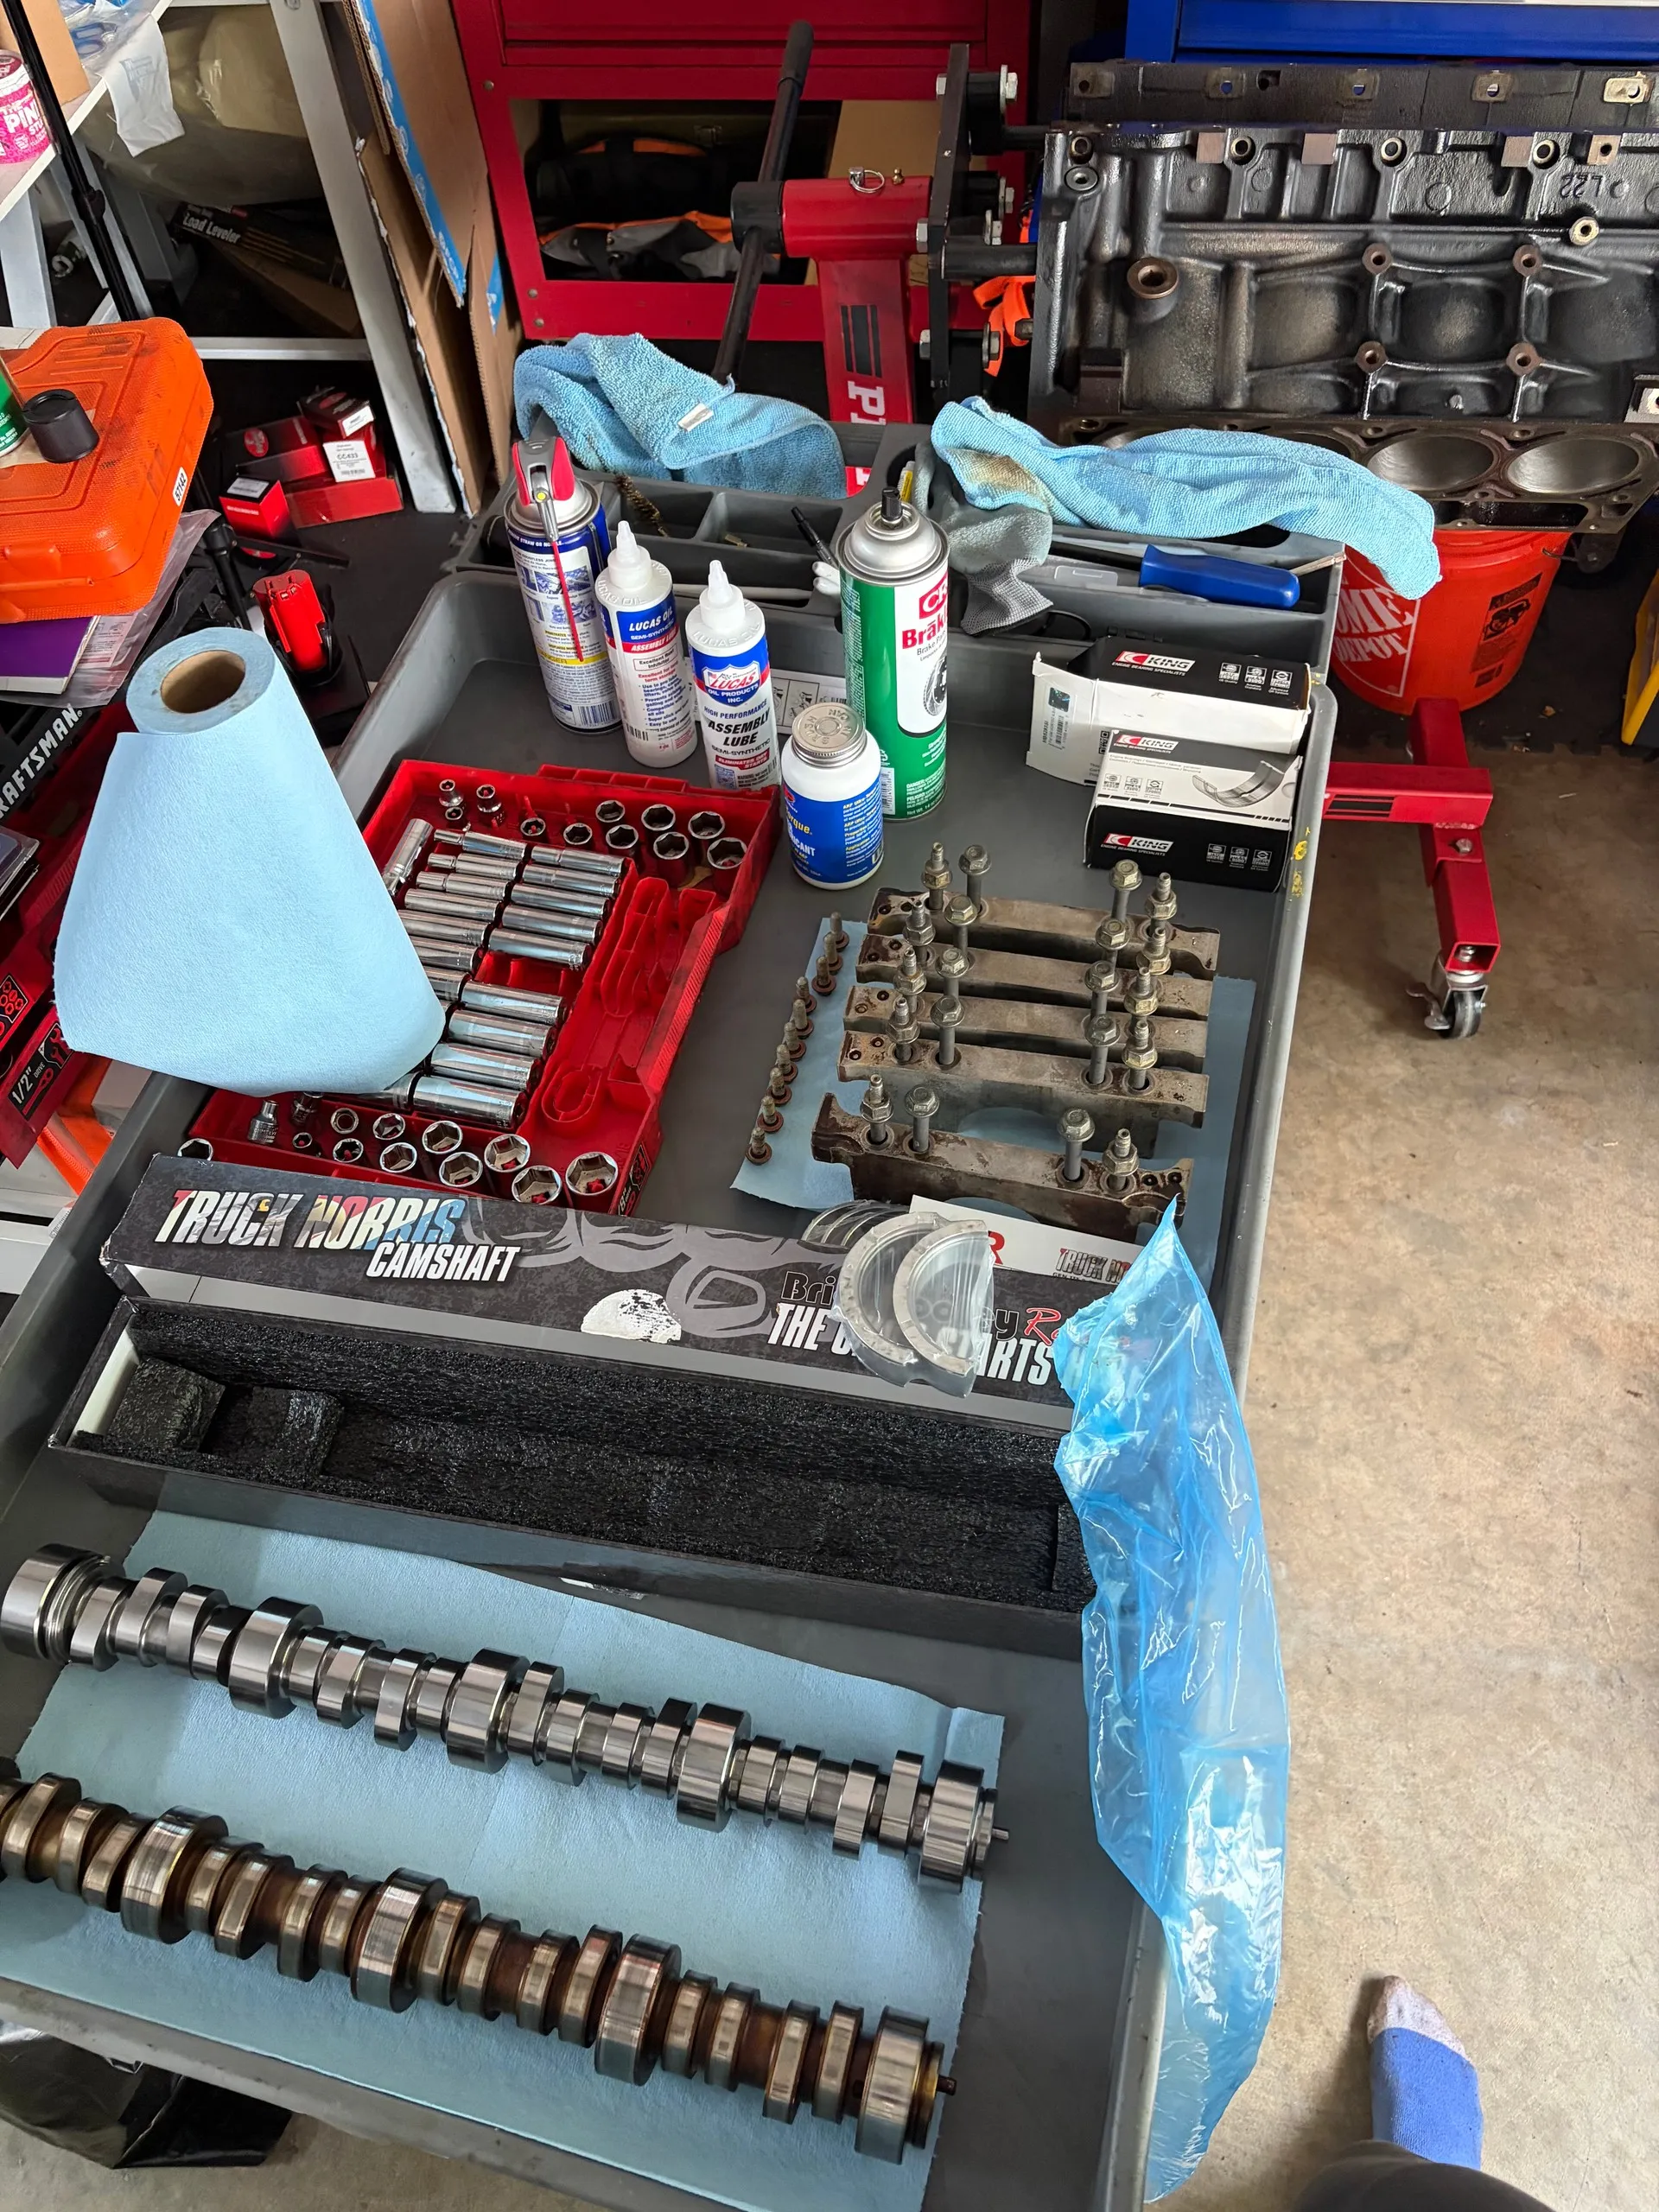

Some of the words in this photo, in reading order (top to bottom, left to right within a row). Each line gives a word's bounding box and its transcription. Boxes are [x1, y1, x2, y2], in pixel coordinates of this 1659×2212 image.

[182, 213, 207, 232] Load
[206, 221, 242, 244] Leveler
[629, 615, 662, 632] LUCAS
[631, 636, 665, 652] ASSEMBLY
[917, 641, 936, 656] Brake
[1147, 657, 1191, 669] KING
[1154, 668, 1186, 677] SPECIALISTS
[708, 688, 720, 696] OIL
[721, 683, 760, 697] PRODUCTS
[709, 671, 756, 690] LUCAS
[704, 706, 718, 718] HIGH
[720, 698, 768, 719] PERFORMANCE
[708, 708, 770, 734] ASSEMBLY
[711, 738, 771, 756] SEMI-SYNTHETIC
[723, 731, 759, 747] LUBE
[1141, 739, 1173, 749] KING
[0, 702, 80, 818] RAFTSMAN
[1132, 839, 1169, 851] KING
[12, 1065, 35, 1104] 1/2"
[33, 1061, 47, 1078] DRIVE
[154, 1189, 304, 1248] TRUCK
[294, 1193, 467, 1251] NORRIS
[365, 1241, 521, 1283] CAMSHAFT
[1056, 1248, 1108, 1280] TRUCK
[781, 1271, 836, 1306] Bri
[767, 1302, 833, 1351] THE
